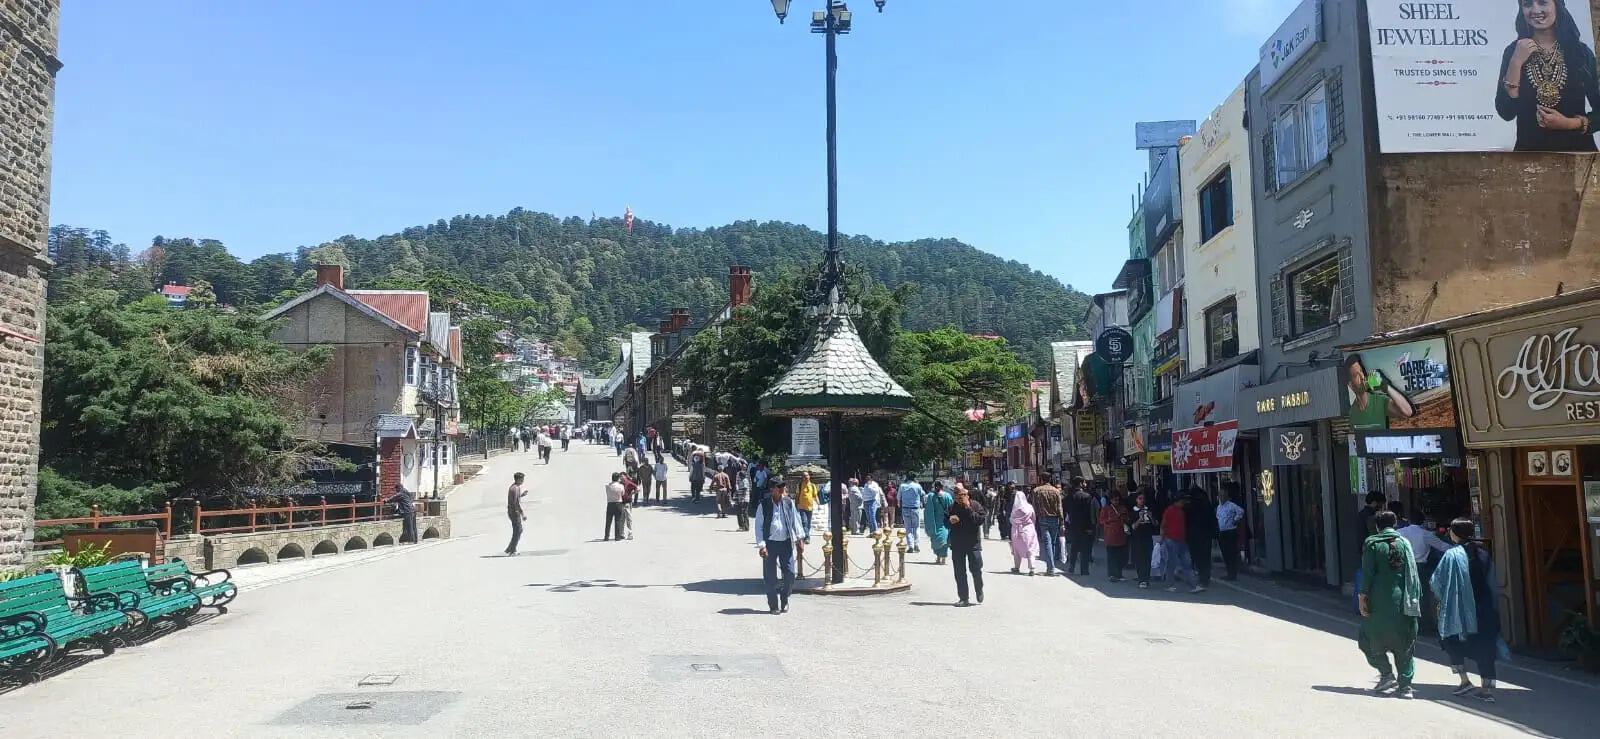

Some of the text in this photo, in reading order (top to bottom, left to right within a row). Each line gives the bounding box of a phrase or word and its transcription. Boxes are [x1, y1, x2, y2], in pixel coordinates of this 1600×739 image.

[1399, 3, 1460, 20] SHEEL
[1281, 24, 1310, 61] J&K Bank
[1376, 28, 1488, 46] JEWELLERS
[1394, 69, 1478, 77] TRUSTED SINCE 1950
[1404, 374, 1429, 391] JEET
[1256, 391, 1310, 413] RARE RABBIT
